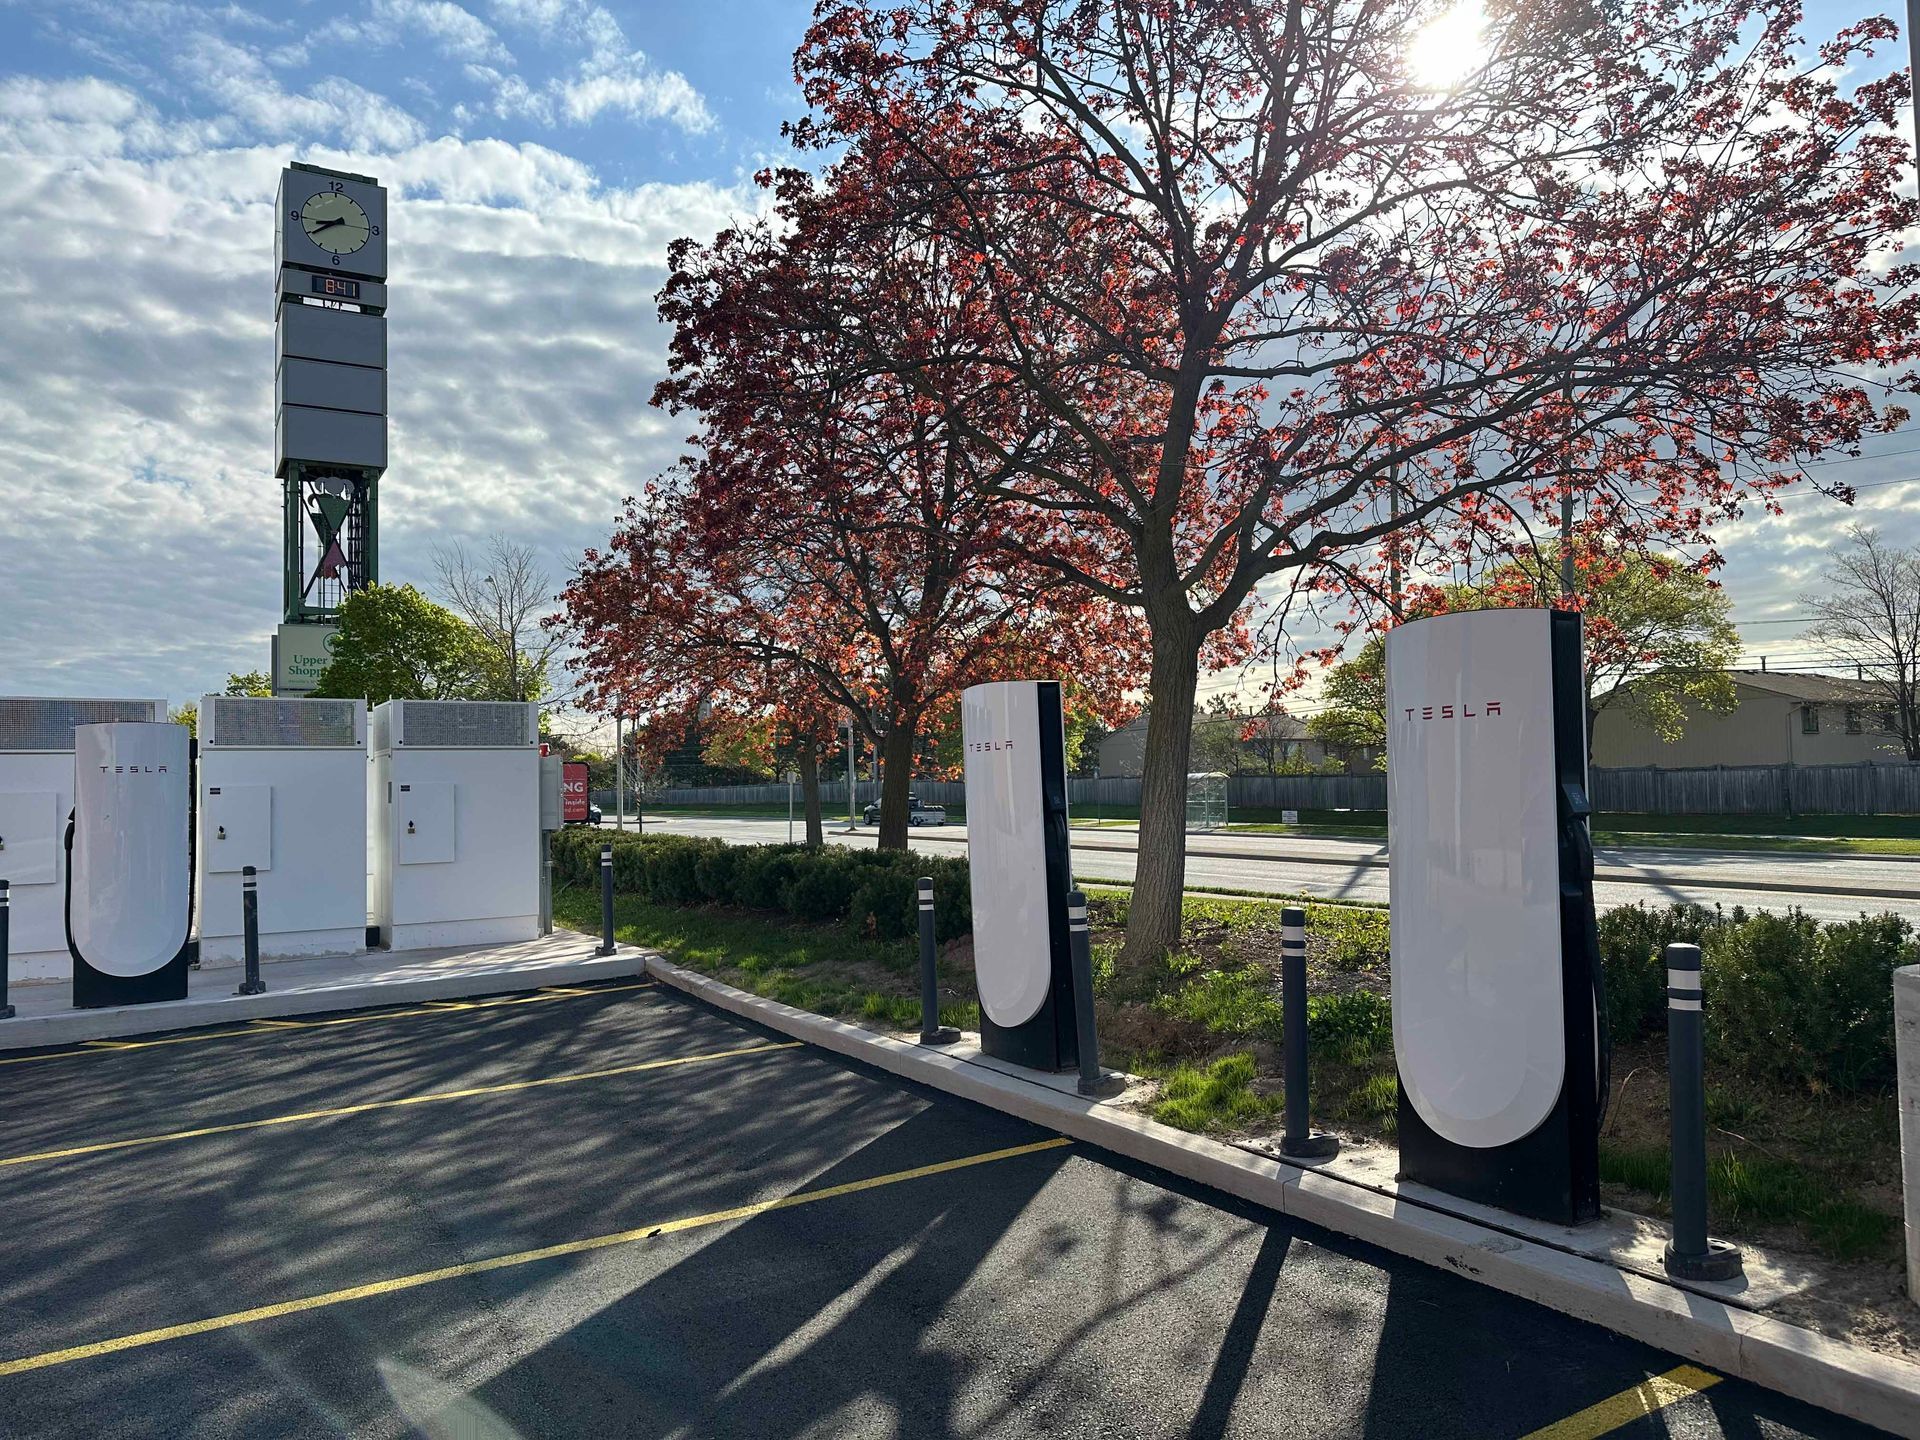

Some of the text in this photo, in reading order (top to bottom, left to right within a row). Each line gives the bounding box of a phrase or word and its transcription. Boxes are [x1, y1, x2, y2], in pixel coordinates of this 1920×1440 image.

[328, 181, 344, 193] 12
[290, 211, 300, 221] 9
[371, 225, 380, 236] 3
[331, 255, 341, 266] 6
[293, 655, 328, 667] Upper
[1405, 702, 1501, 721] TESLA
[969, 740, 1013, 752] TESLA
